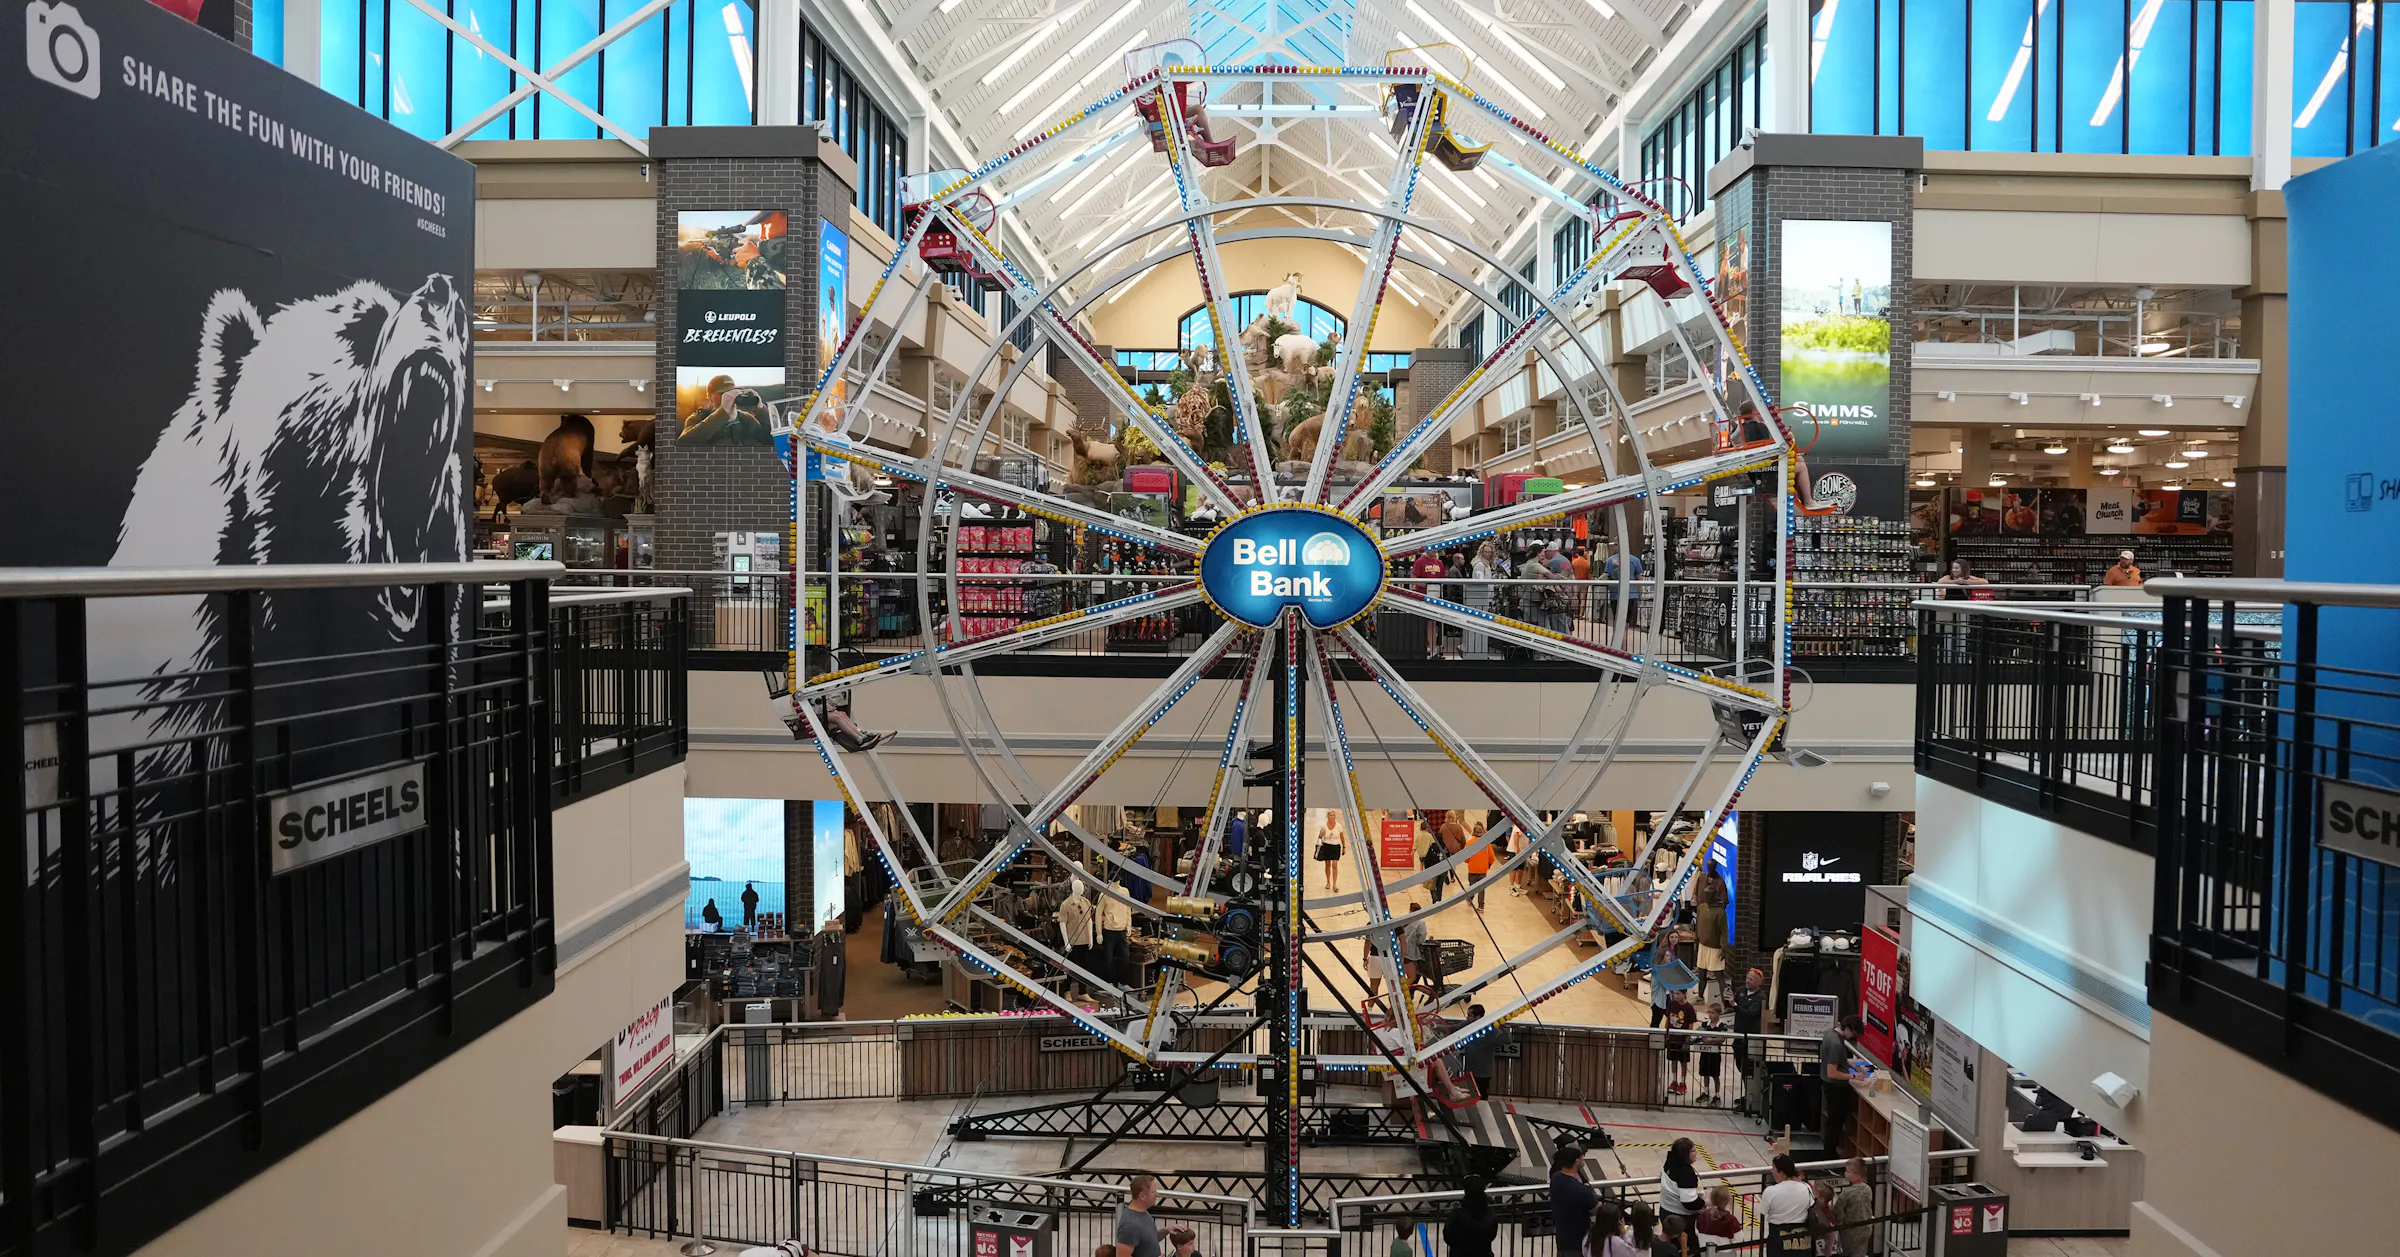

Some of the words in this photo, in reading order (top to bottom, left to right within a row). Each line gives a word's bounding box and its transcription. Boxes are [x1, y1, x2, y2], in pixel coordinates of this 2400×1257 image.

[122, 55, 197, 113] SHARE
[204, 90, 242, 132] THE
[249, 110, 284, 149] FUN
[290, 128, 334, 170] WITH
[339, 150, 380, 190] YOUR
[385, 170, 446, 217] FRIENDS!
[417, 217, 446, 238] #SCHEELS
[718, 313, 756, 321] LEUPOLD
[683, 328, 703, 344] BE
[703, 328, 778, 345] RELENTLESS
[1821, 475, 1847, 495] BONES
[2096, 508, 2124, 520] Church
[2100, 501, 2120, 511] Meat
[1233, 538, 1297, 566] Bell
[1250, 570, 1333, 597] Bank
[1742, 722, 1764, 731] YETI
[278, 780, 420, 850] SCHEELS
[1782, 872, 1861, 882] RIVALRIES
[1863, 958, 1876, 986] $75
[1794, 1003, 1814, 1012] FERRIS
[1814, 1005, 1831, 1014] WHEEL
[1042, 1037, 1105, 1048] SCHEELS
[619, 1066, 632, 1087] TWINS,
[633, 1057, 643, 1076] WILD
[651, 1045, 658, 1059] MN
[658, 1034, 670, 1054] UNITED
